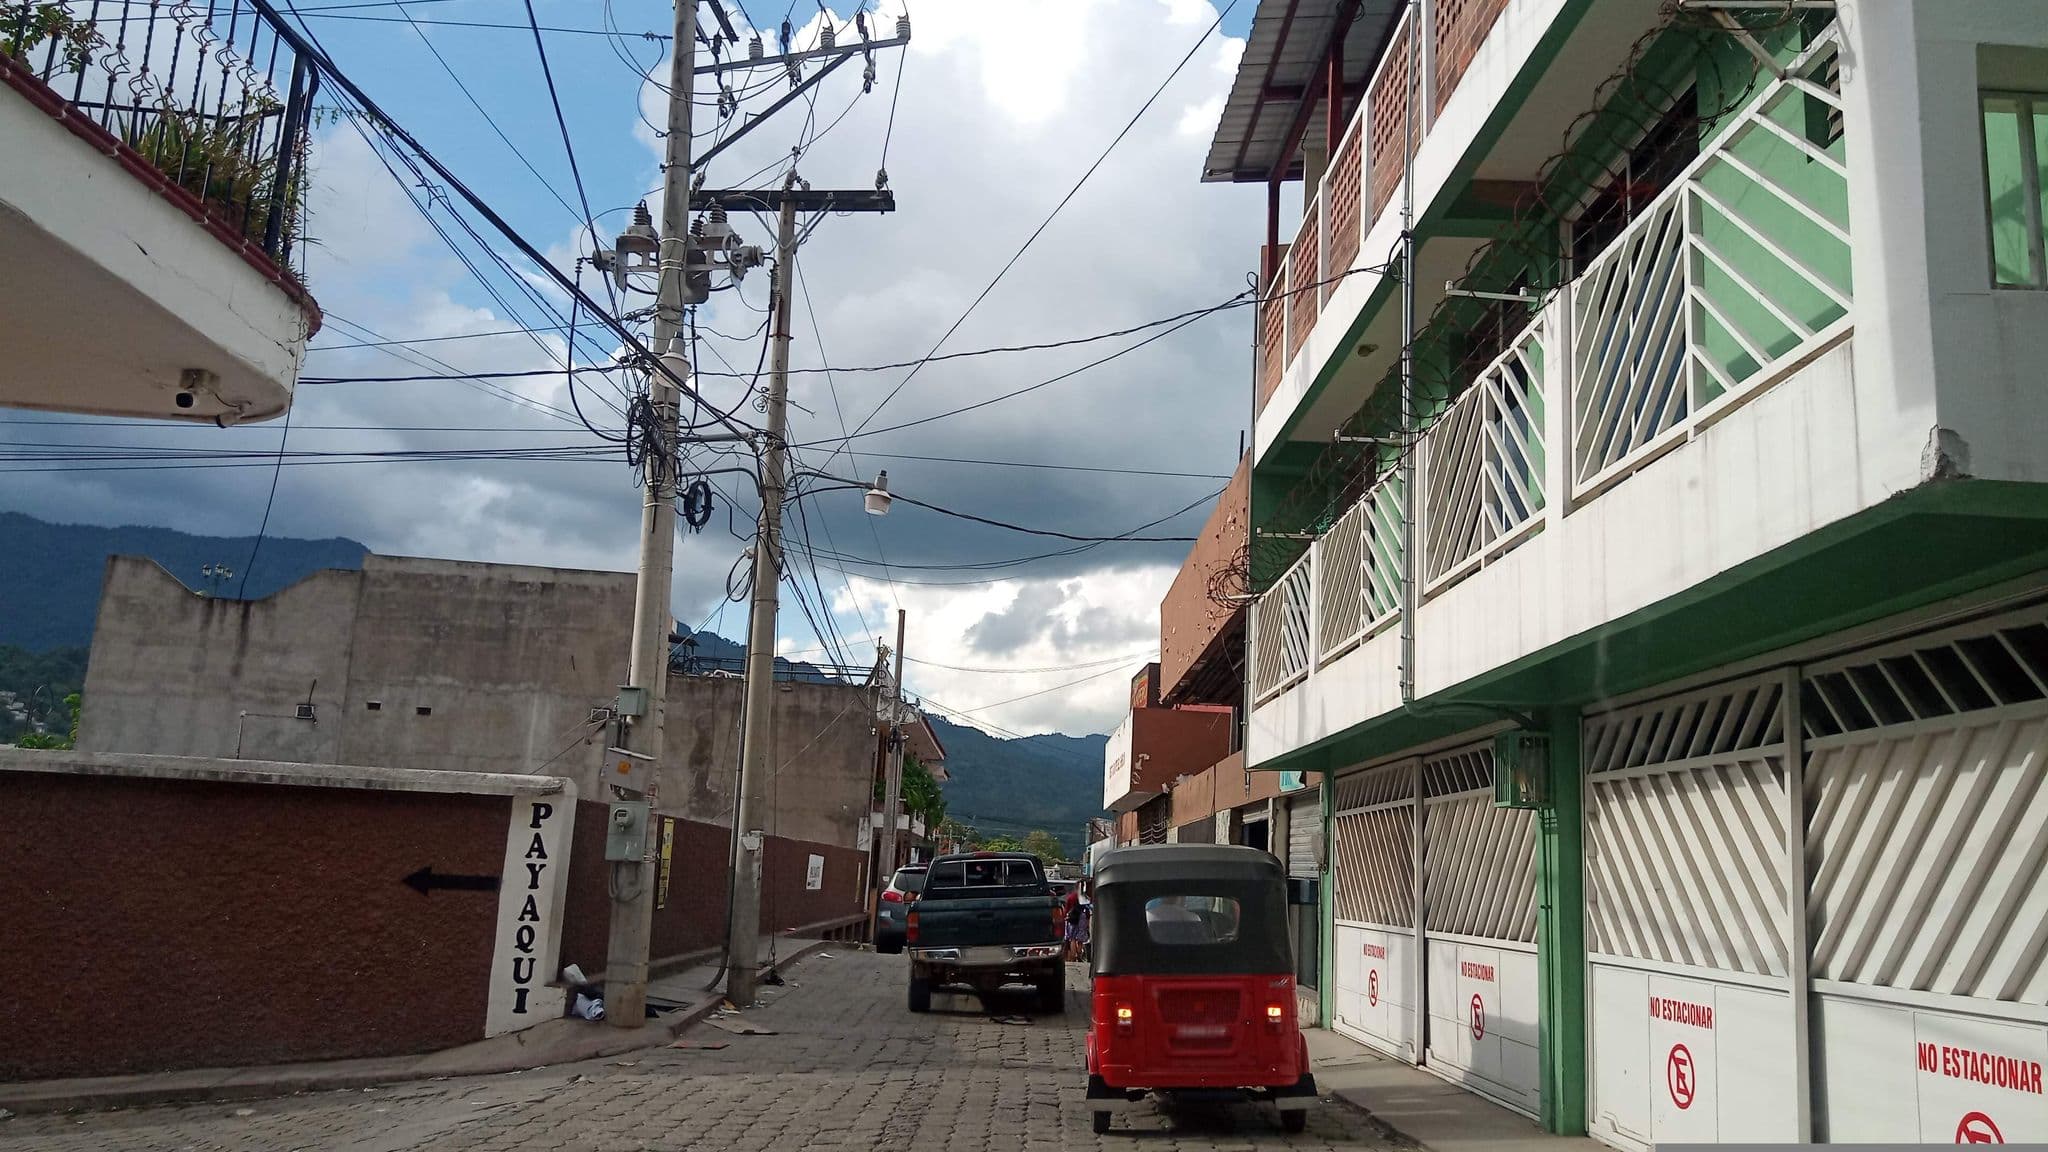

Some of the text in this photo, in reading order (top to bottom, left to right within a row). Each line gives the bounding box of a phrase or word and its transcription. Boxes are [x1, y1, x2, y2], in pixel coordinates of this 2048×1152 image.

[512, 802, 553, 1014] PAYAQUI
[1461, 961, 1495, 983] NO ESTACIONAR
[1650, 996, 1713, 1030] NO ESTACIONAR
[1918, 1041, 2043, 1095] NO ESTACIONAR
